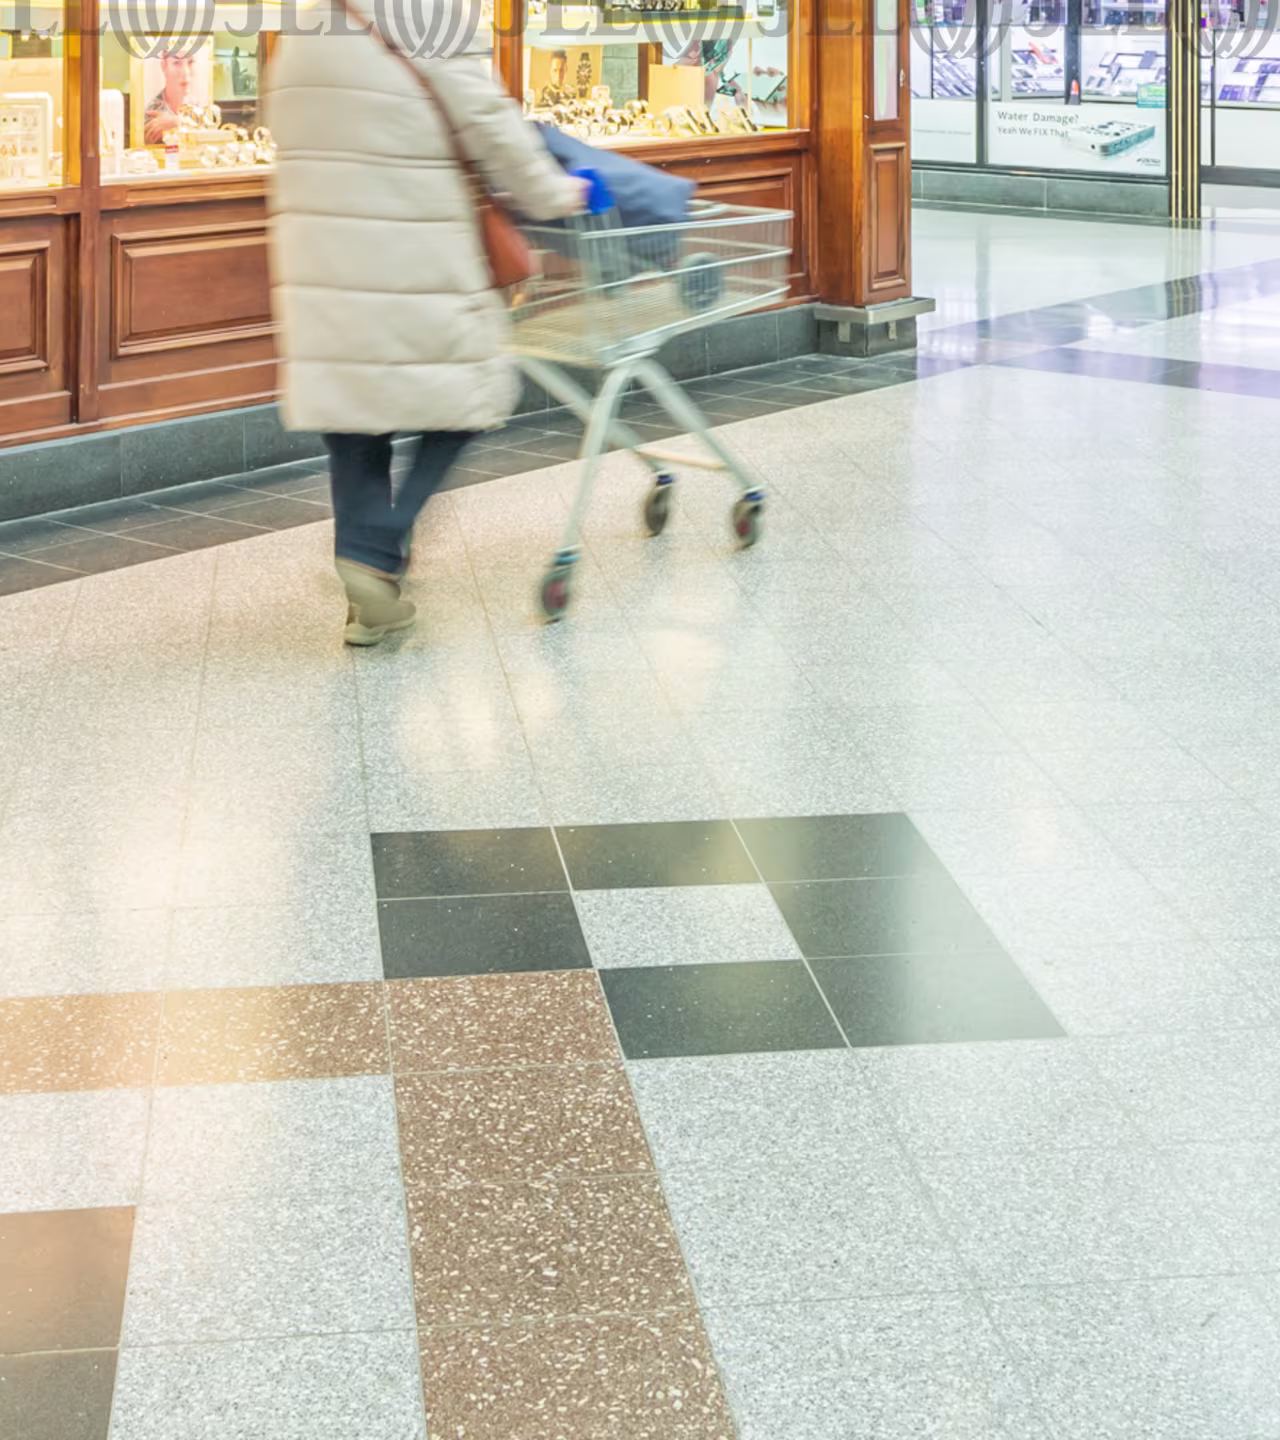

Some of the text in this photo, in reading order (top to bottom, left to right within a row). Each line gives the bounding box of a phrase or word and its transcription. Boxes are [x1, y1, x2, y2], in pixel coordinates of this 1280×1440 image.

[997, 111, 1079, 125] Water Damage?
[997, 126, 1018, 135] Yeah
[1018, 127, 1033, 136] We
[1033, 127, 1048, 136] FIX
